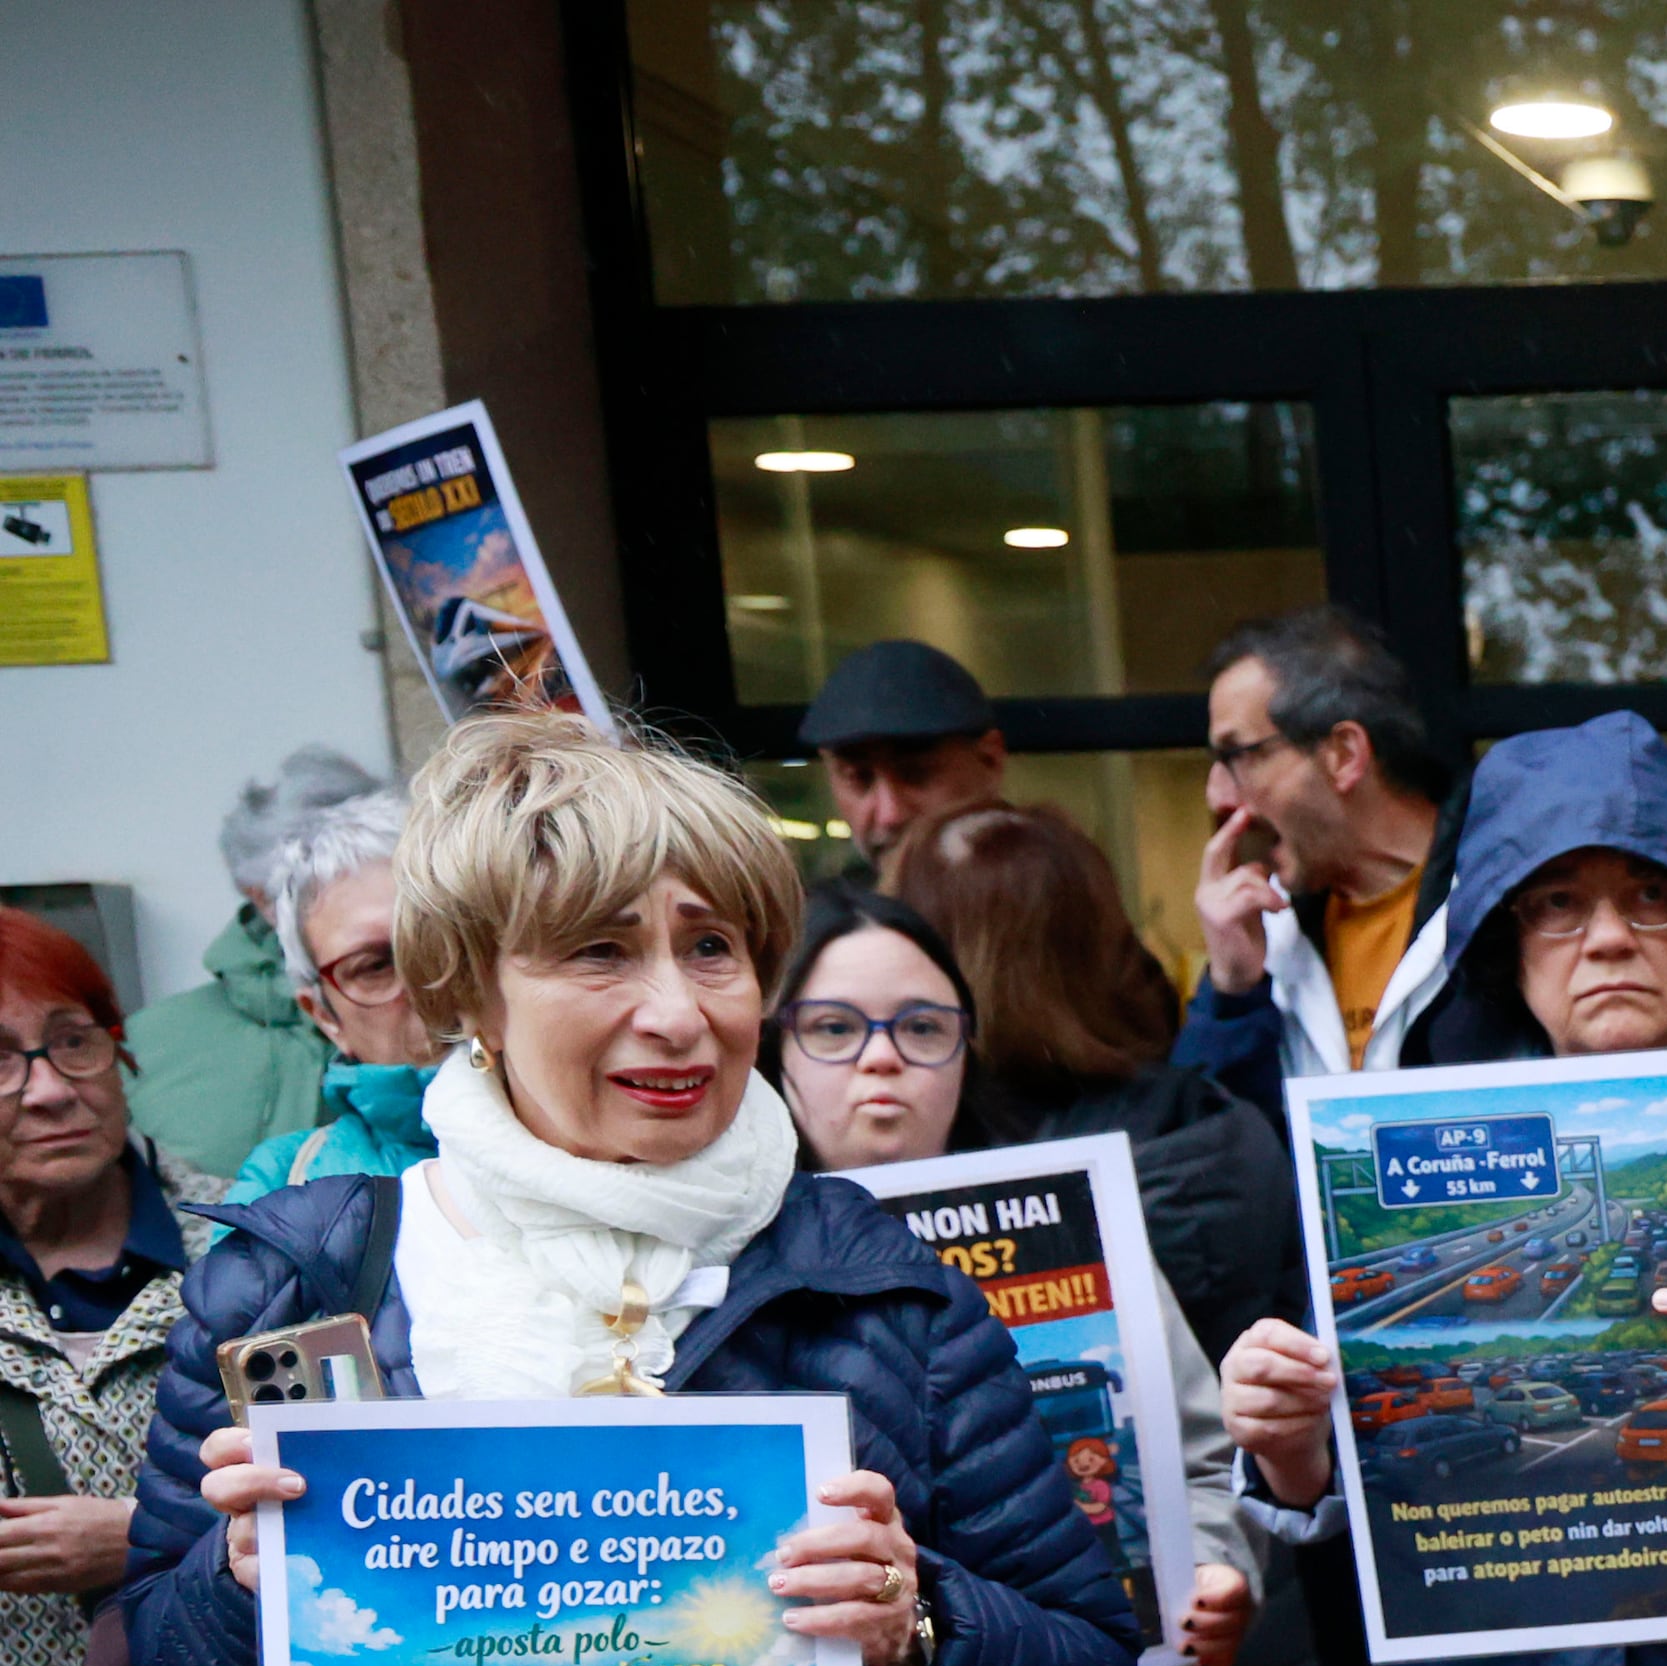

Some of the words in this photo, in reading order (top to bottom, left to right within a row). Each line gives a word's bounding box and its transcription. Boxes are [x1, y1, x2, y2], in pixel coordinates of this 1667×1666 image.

[440, 473, 483, 513] XXI
[1440, 1127, 1487, 1147] AP-9
[1386, 1156, 1405, 1177] A
[1406, 1153, 1476, 1176] Coruña
[1446, 1179, 1468, 1197] 55
[1469, 1177, 1497, 1194] km
[906, 1203, 990, 1242] NON
[995, 1192, 1062, 1232] HAI
[937, 1238, 1018, 1278] OS?
[983, 1272, 1097, 1319] NTEN!!
[341, 1477, 504, 1530] Cidades
[514, 1490, 582, 1519] sen
[591, 1471, 739, 1521] coches,
[1390, 1502, 1434, 1522] Non
[1436, 1495, 1531, 1522] queremos
[1535, 1491, 1588, 1515] pagar
[364, 1533, 440, 1570] aire
[450, 1527, 559, 1580] limpo
[569, 1538, 590, 1564] e
[599, 1534, 726, 1576] espazo
[1414, 1530, 1494, 1553] baleirar
[1499, 1531, 1515, 1547] o
[1518, 1525, 1564, 1549] peto
[1566, 1521, 1599, 1541] nin
[1602, 1517, 1633, 1538] dar
[1423, 1563, 1470, 1587] para
[1472, 1557, 1542, 1582] atopar
[435, 1582, 527, 1624] para
[535, 1578, 663, 1620] gozar:
[573, 1612, 641, 1665] polo
